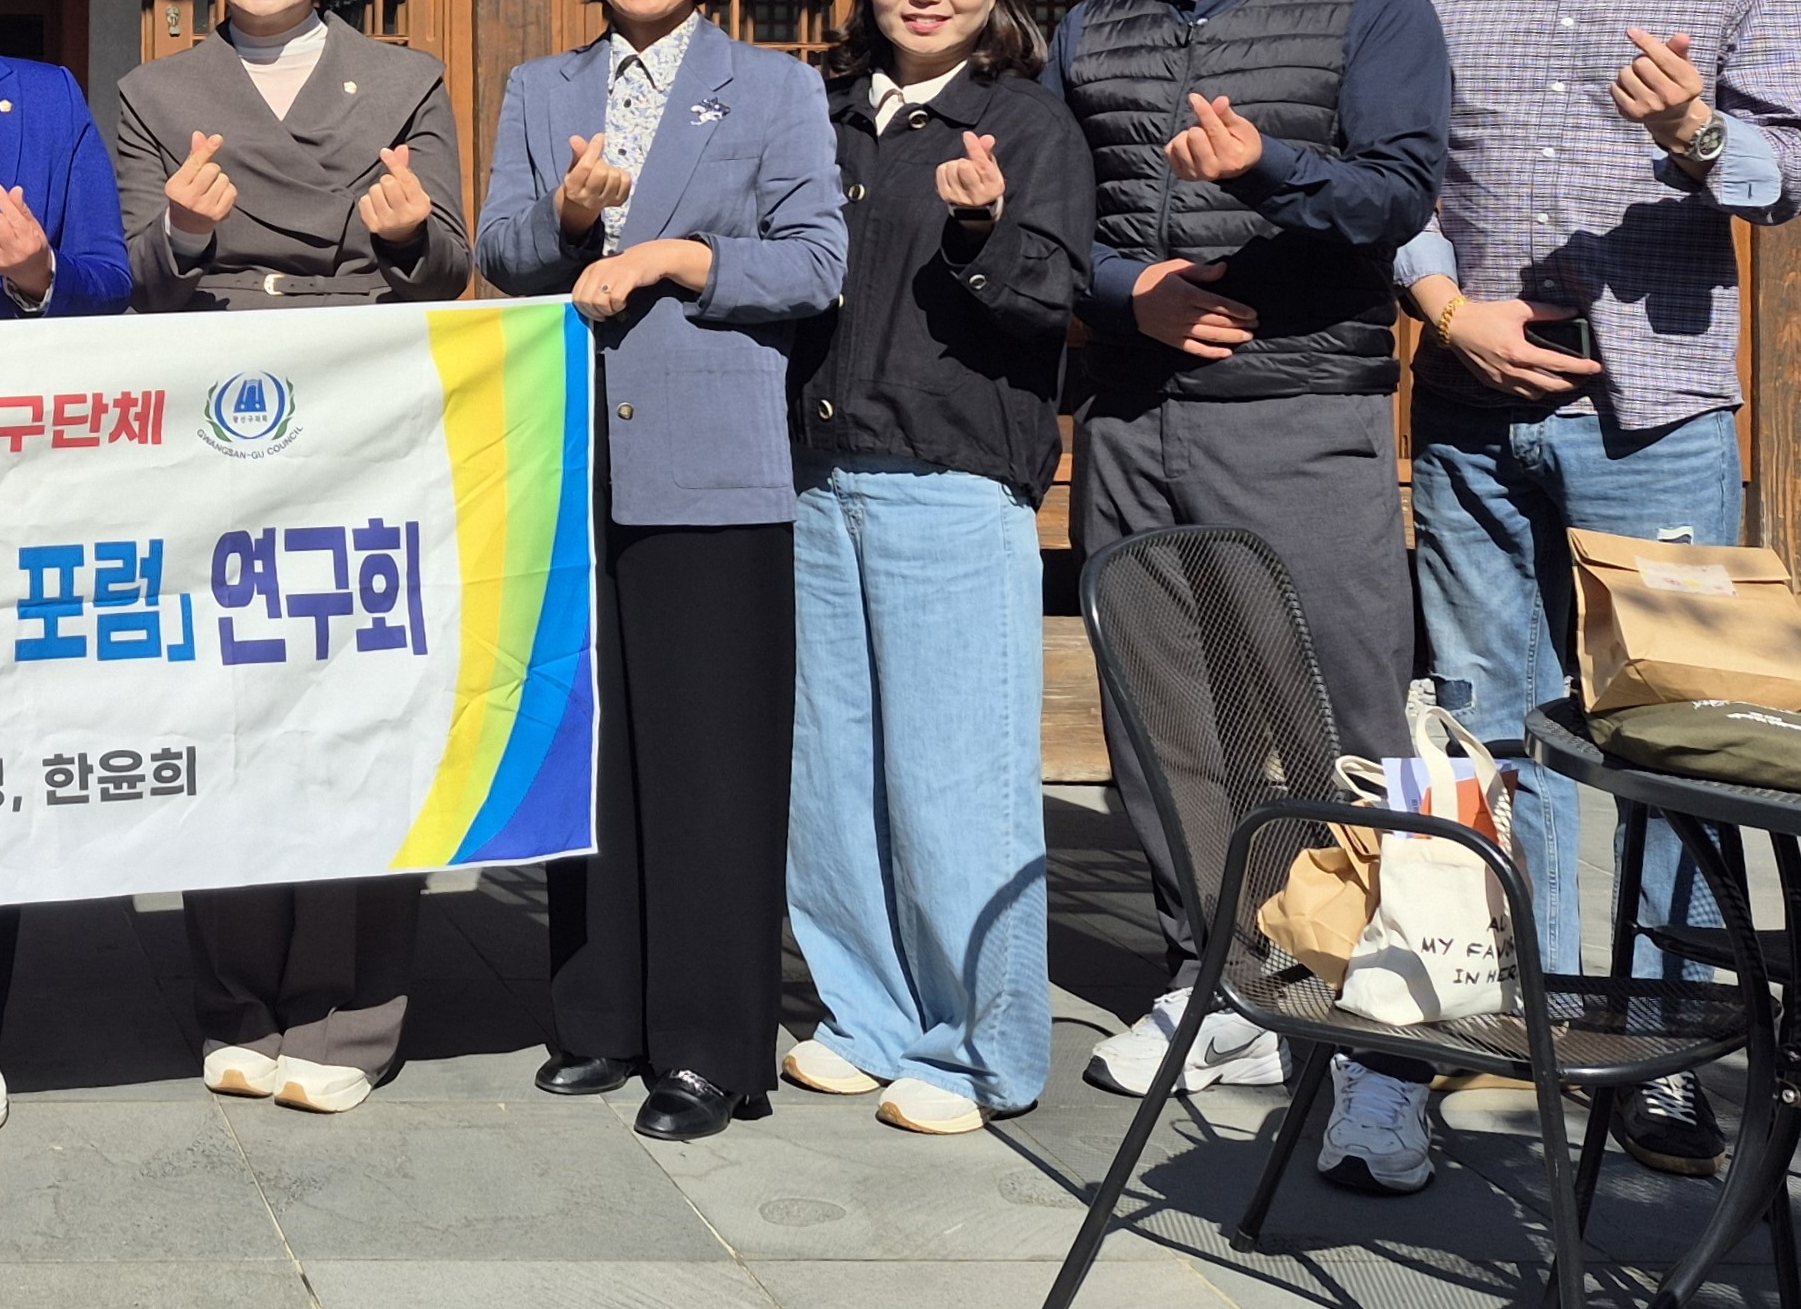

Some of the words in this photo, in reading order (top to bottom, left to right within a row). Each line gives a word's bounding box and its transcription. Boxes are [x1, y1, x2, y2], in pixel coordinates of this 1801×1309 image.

[196, 428, 265, 460] GWANGSAN-GU
[266, 425, 304, 456] COUNCIL
[15, 539, 197, 664] 포럼」
[209, 517, 426, 664] 연구회
[42, 746, 197, 805] 한윤희
[1420, 936, 1454, 956] MY
[1452, 968, 1480, 985] IN
